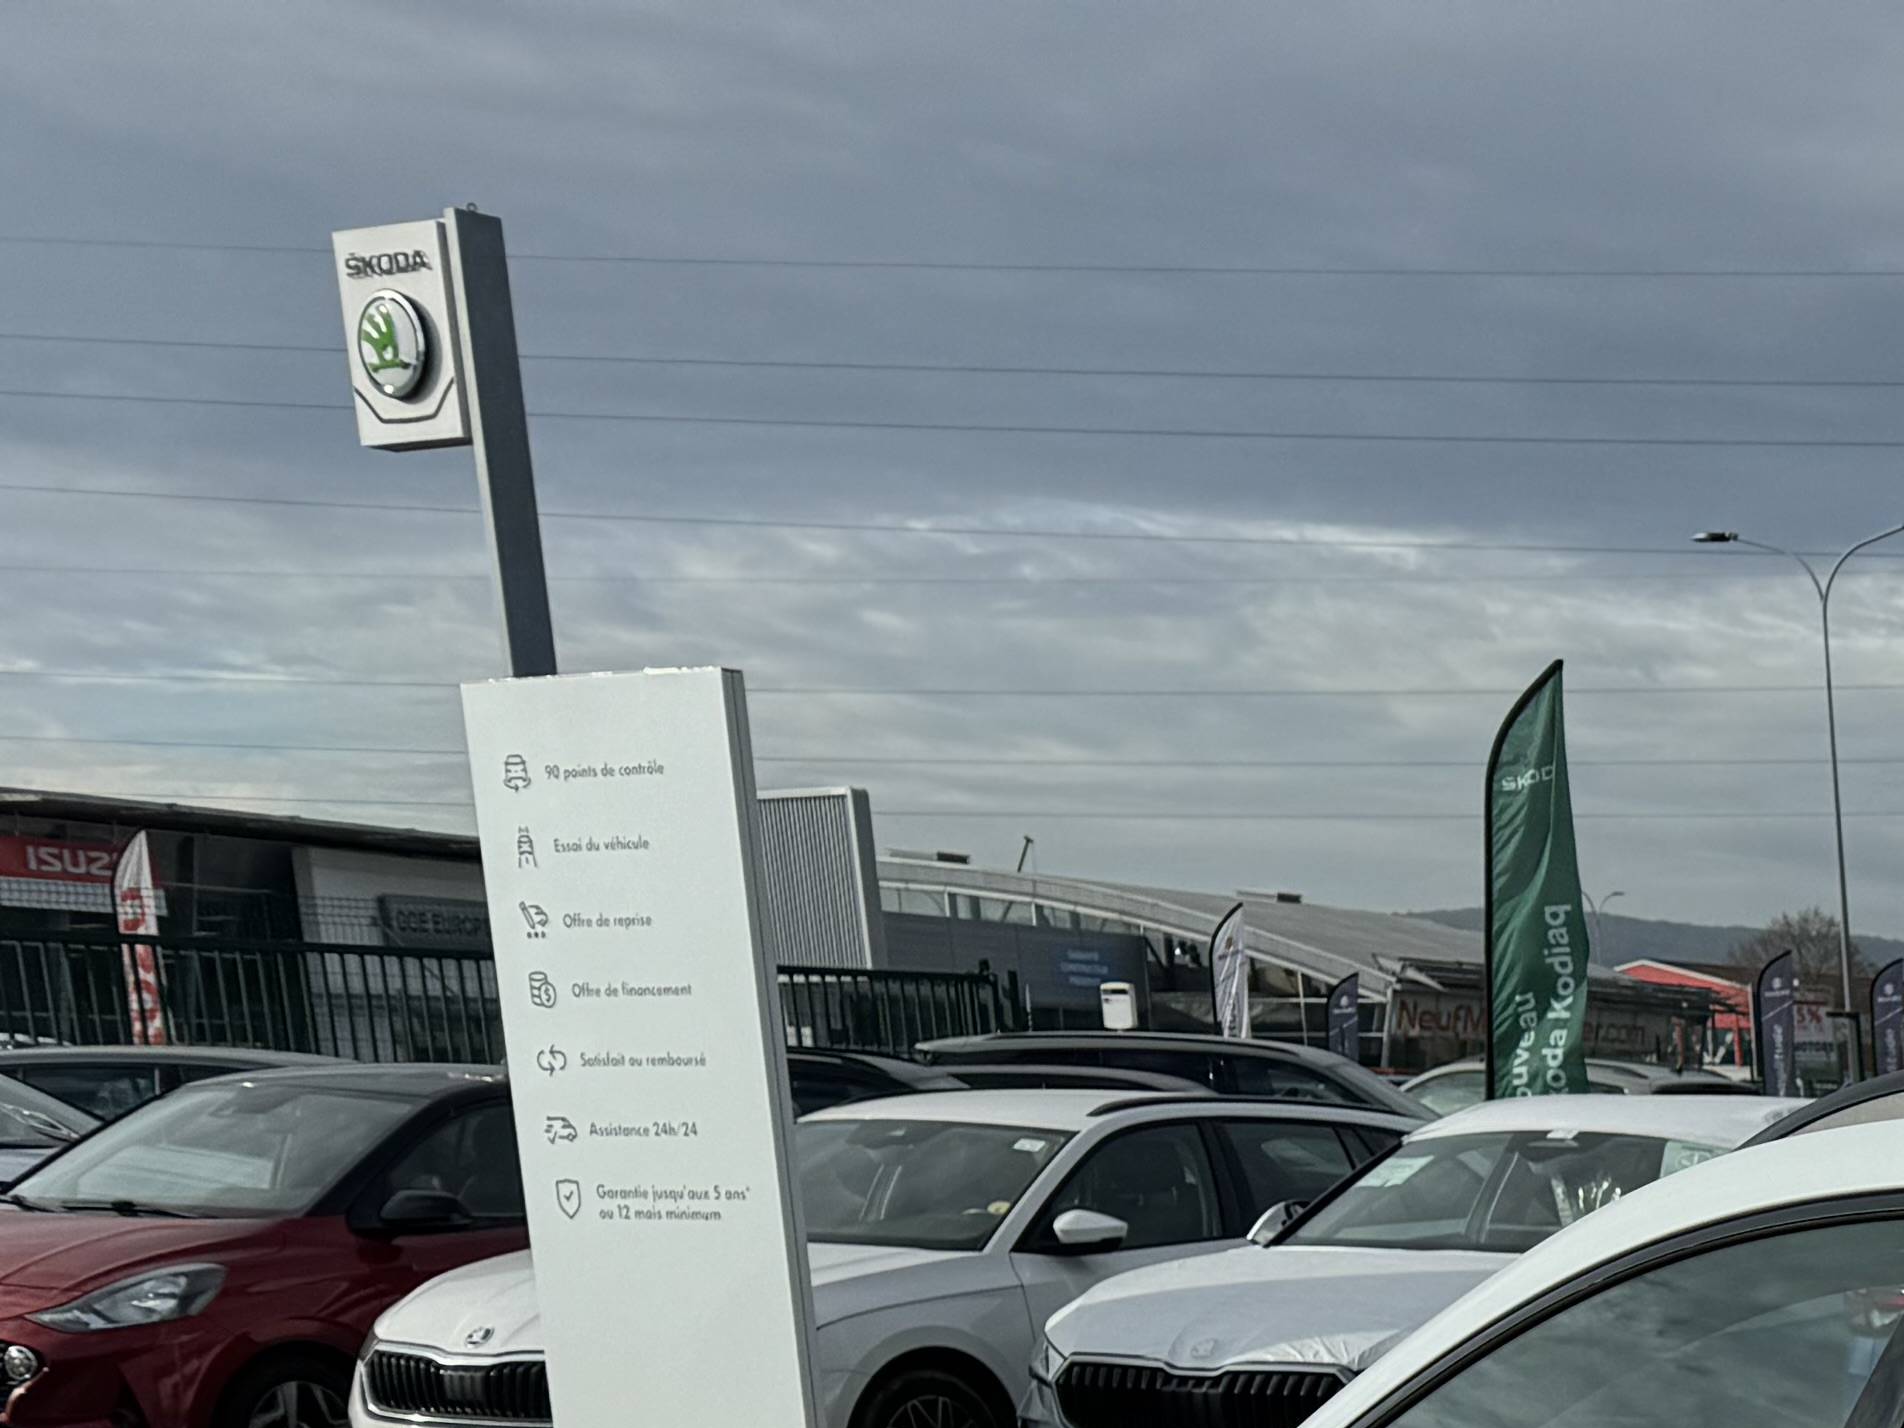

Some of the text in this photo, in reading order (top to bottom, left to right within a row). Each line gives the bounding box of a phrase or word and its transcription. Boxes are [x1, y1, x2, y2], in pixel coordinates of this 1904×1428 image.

[544, 759, 664, 780] 90 points de contrôle
[553, 834, 650, 853] Essai du véhicule
[25, 845, 117, 876] ISUZ
[562, 911, 653, 929] Offre de reprise
[1544, 903, 1575, 1019] Kodiaq
[571, 981, 692, 998] Offre de financement
[579, 1051, 707, 1067] Satisfait ou remboursé
[589, 1120, 698, 1136] Assistance 24h/24
[596, 1184, 648, 1200] Garantie
[713, 1184, 722, 1200] 5
[599, 1203, 722, 1221] ou 12 mois minimum
